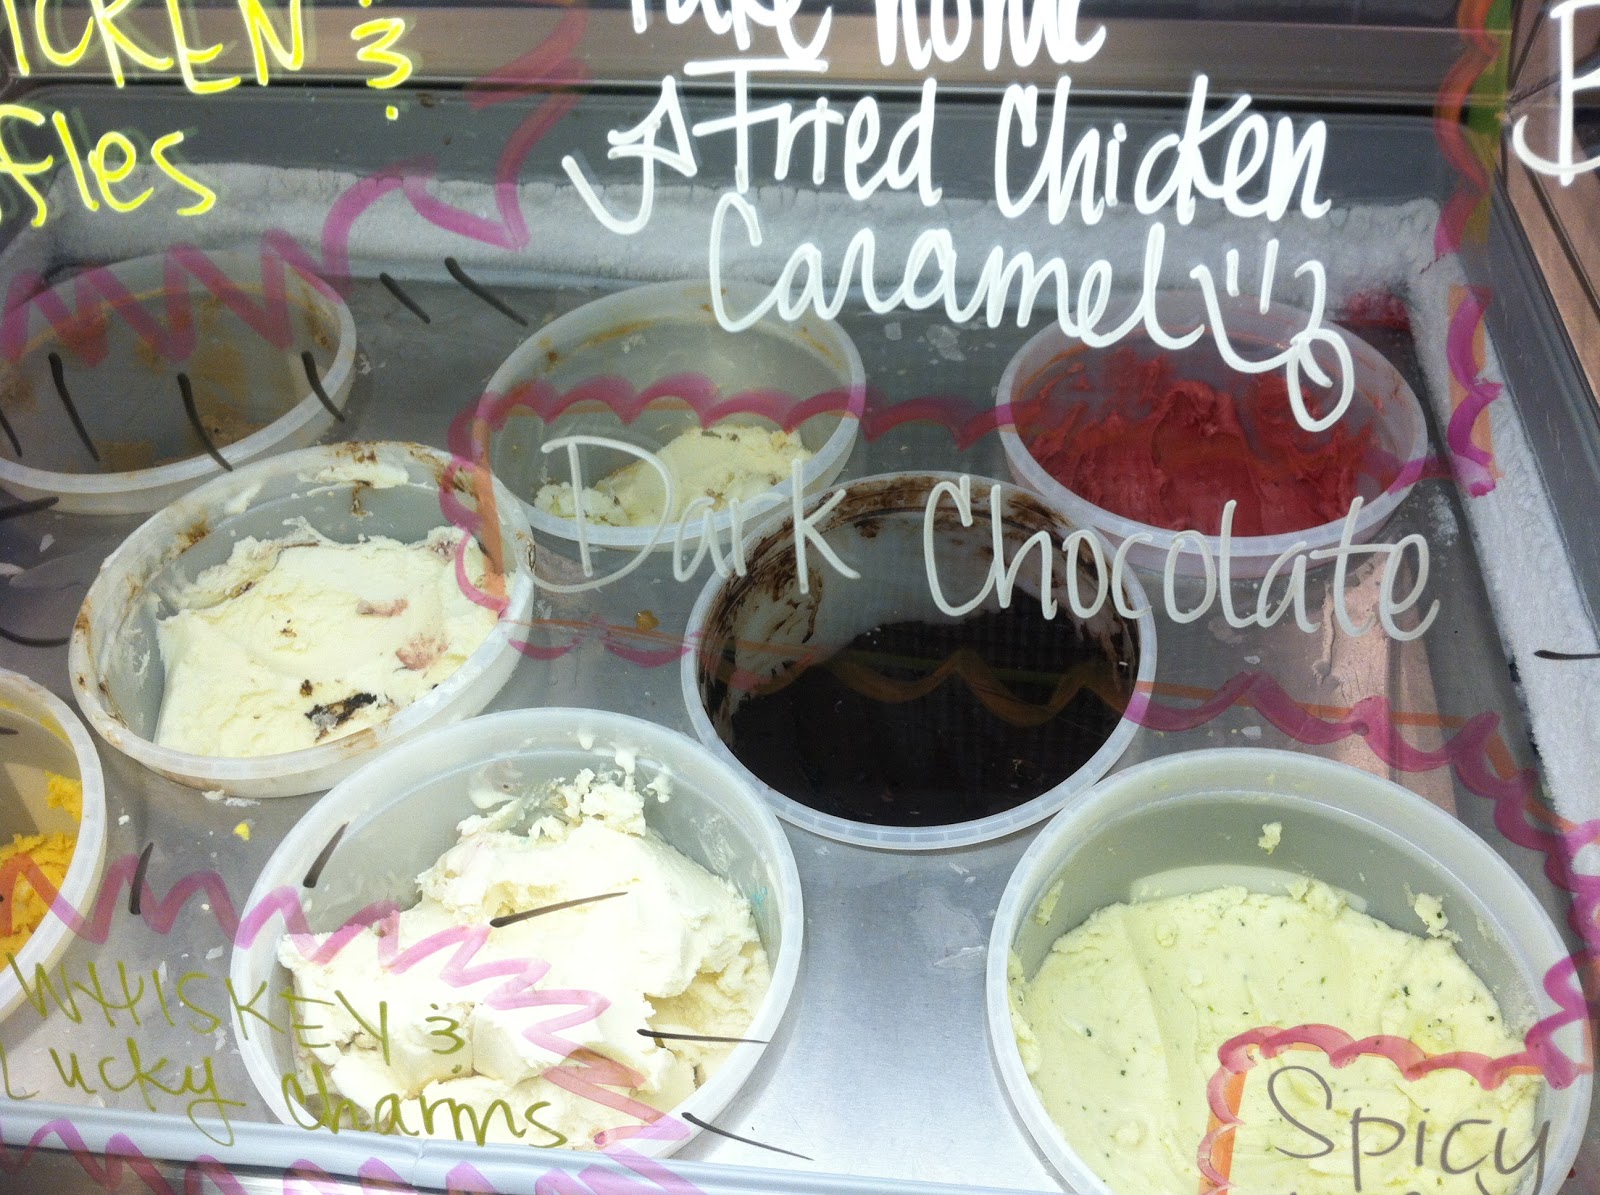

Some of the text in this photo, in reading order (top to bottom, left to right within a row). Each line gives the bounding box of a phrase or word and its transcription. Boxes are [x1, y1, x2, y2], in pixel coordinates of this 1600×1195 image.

[683, 57, 1332, 226] Fried Chicken
[708, 191, 1206, 351] Caramel
[516, 434, 1440, 641] Dark Chocolate
[6, 952, 393, 1067] WHISKEY
[0, 1036, 248, 1148] Lucky
[1266, 1064, 1552, 1195] Spicy
